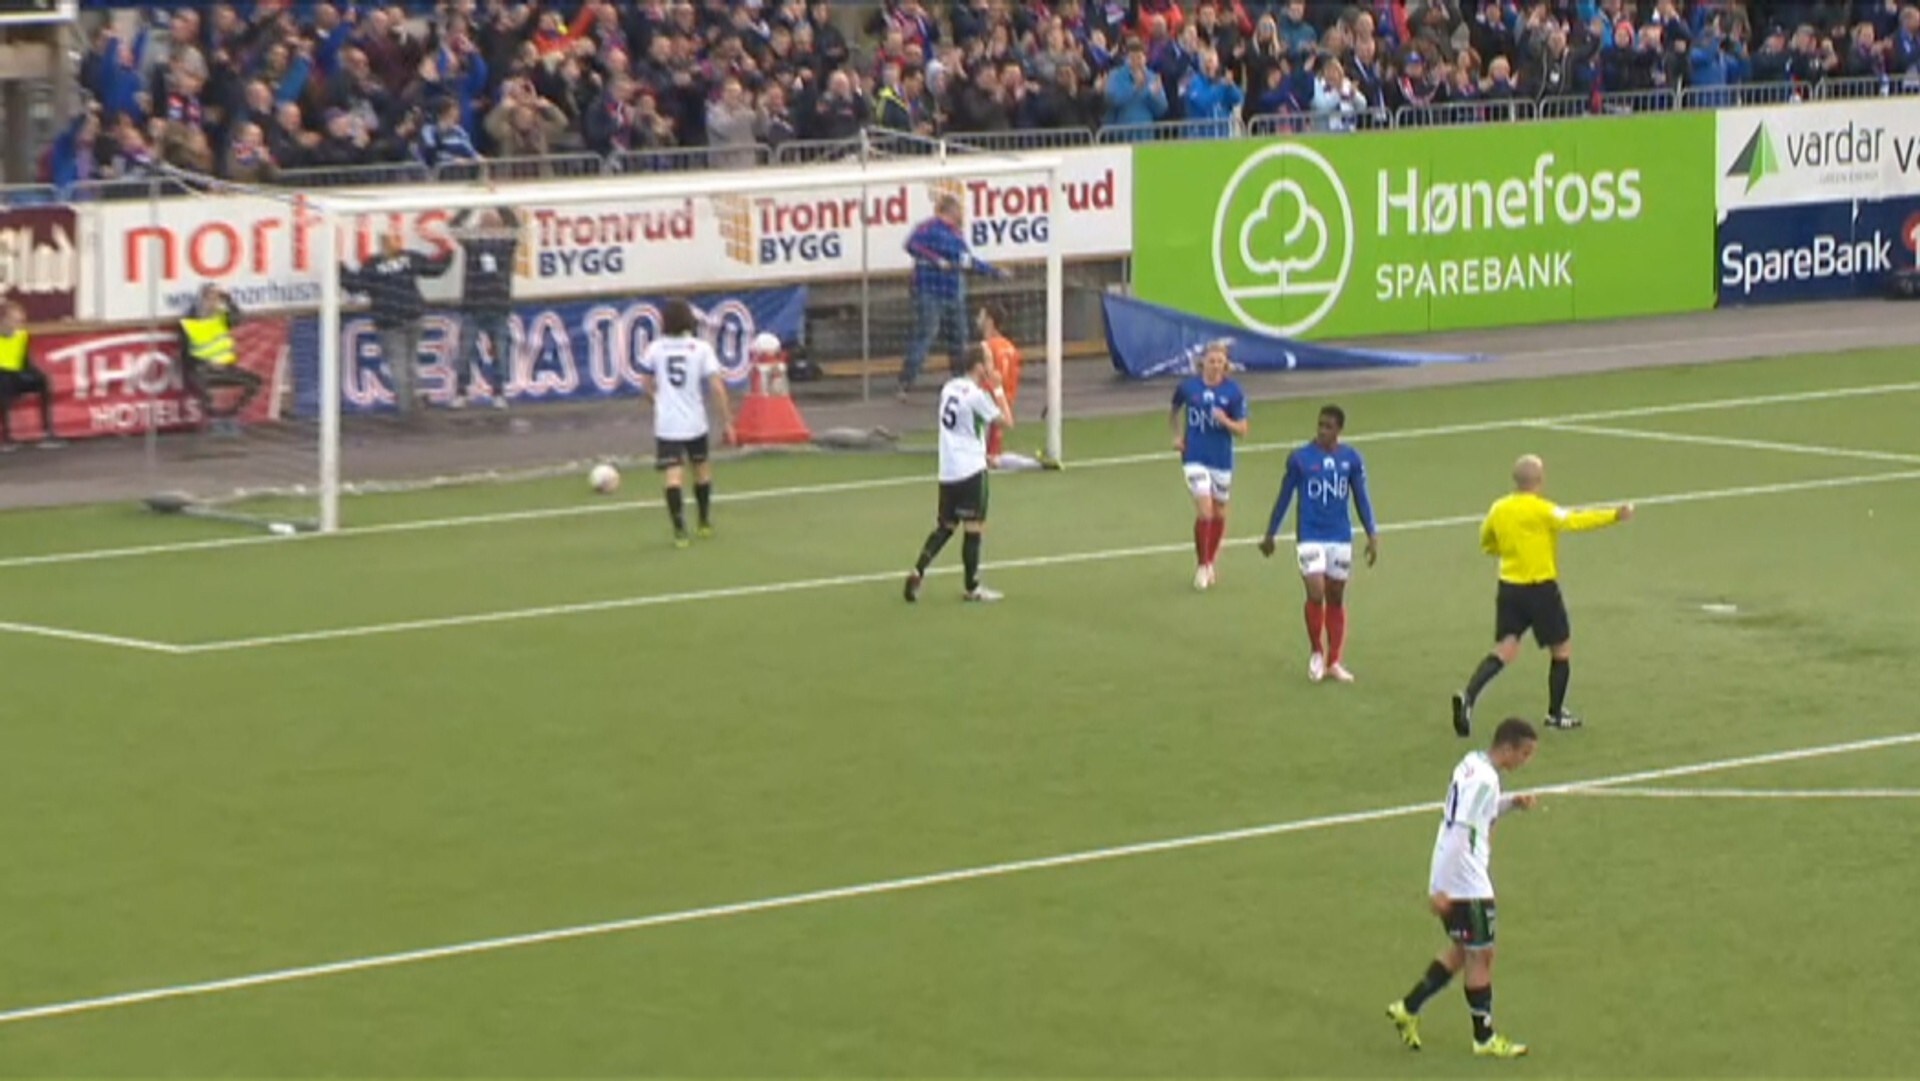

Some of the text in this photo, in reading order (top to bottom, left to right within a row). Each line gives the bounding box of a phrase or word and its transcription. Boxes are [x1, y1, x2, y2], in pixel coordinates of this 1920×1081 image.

[1787, 119, 1885, 168] vardar
[756, 187, 909, 234] Tronrud
[967, 168, 1114, 217] Tronud
[1377, 152, 1643, 236] Hønefoss
[534, 199, 694, 247] Tronrud
[972, 216, 1049, 247] BYGG
[538, 246, 624, 277] BYGG
[759, 232, 842, 265] BYGG
[1721, 229, 1892, 295] SpareBank
[1375, 251, 1574, 301] SPAREBANK
[46, 332, 184, 399] THO
[667, 355, 687, 388] 5
[89, 399, 202, 431] HOTELS
[941, 396, 958, 431] 5
[1307, 469, 1348, 506] DNB
